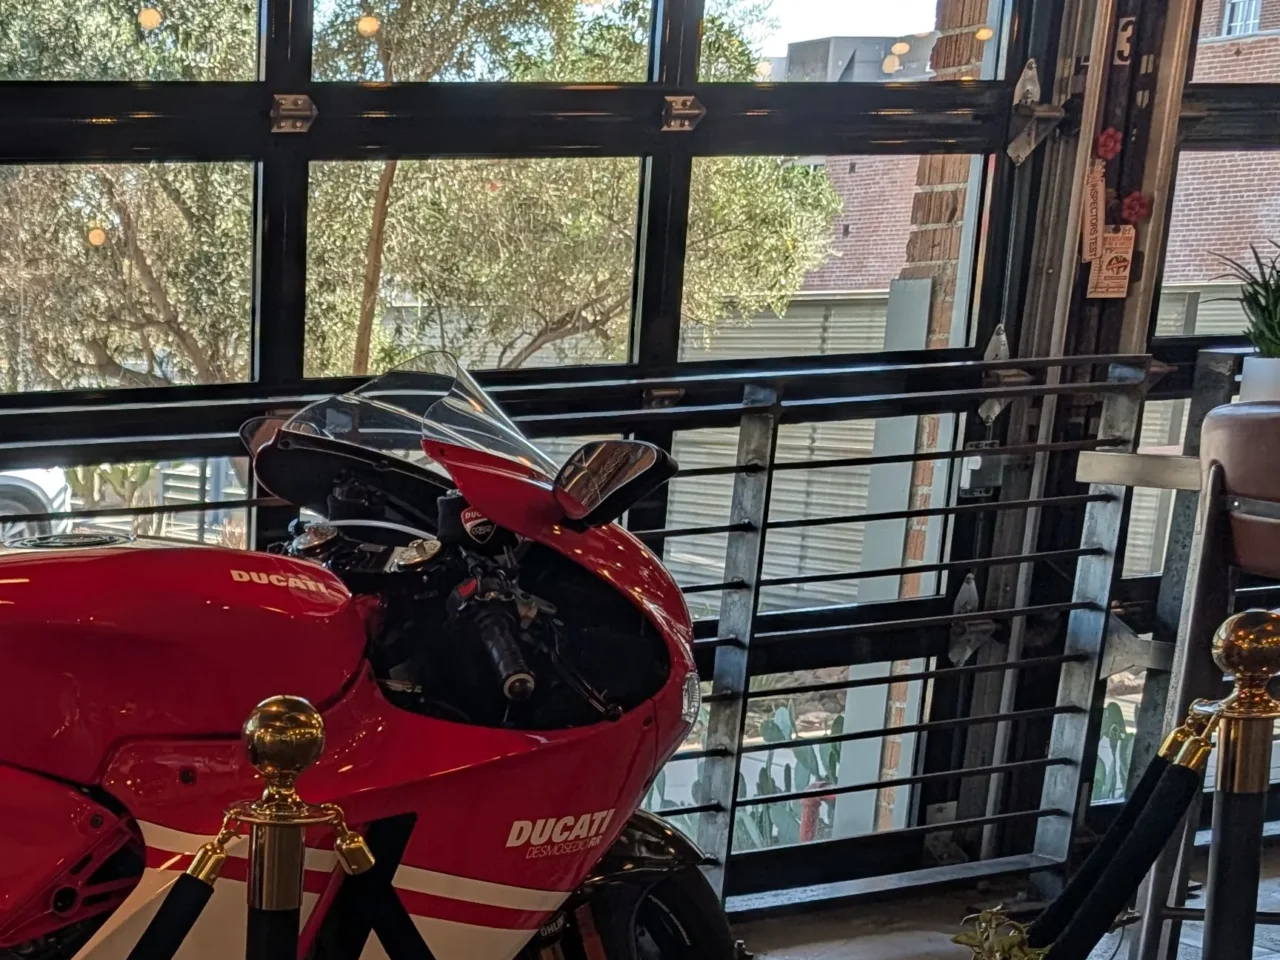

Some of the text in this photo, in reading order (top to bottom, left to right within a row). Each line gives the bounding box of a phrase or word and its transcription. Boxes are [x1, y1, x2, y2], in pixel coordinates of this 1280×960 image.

[1117, 20, 1135, 62] 3
[1088, 183, 1099, 258] INSPECTORS TEST
[230, 569, 328, 594] DUCATI
[505, 808, 616, 848] DUCATI
